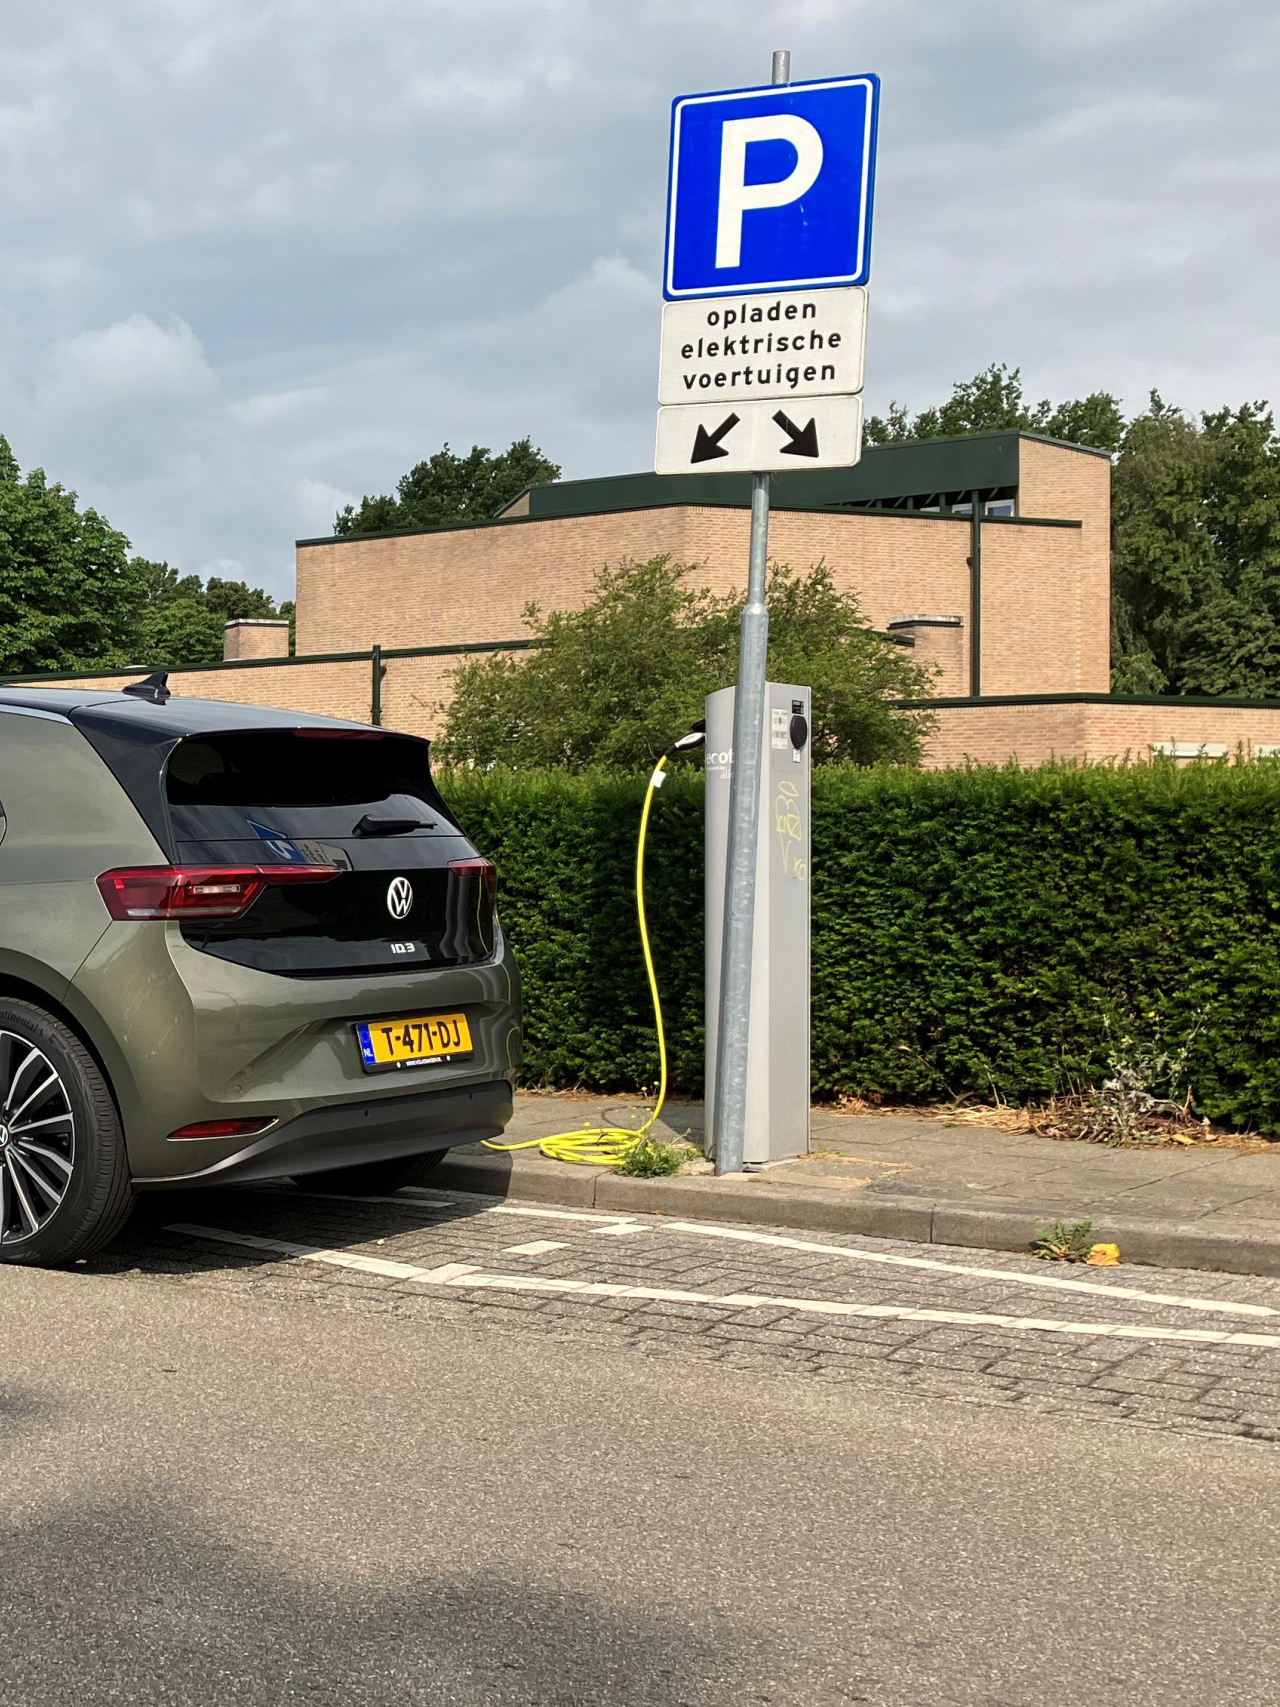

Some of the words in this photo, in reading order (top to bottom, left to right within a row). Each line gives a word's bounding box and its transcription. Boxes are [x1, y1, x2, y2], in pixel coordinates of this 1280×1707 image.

[715, 114, 824, 269] P
[707, 300, 817, 329] opladen
[681, 329, 842, 359] elektrische
[683, 363, 835, 389] voertuigen
[387, 876, 413, 919] VW
[363, 1047, 374, 1058] NL
[380, 1019, 461, 1056] T-471-DJ
